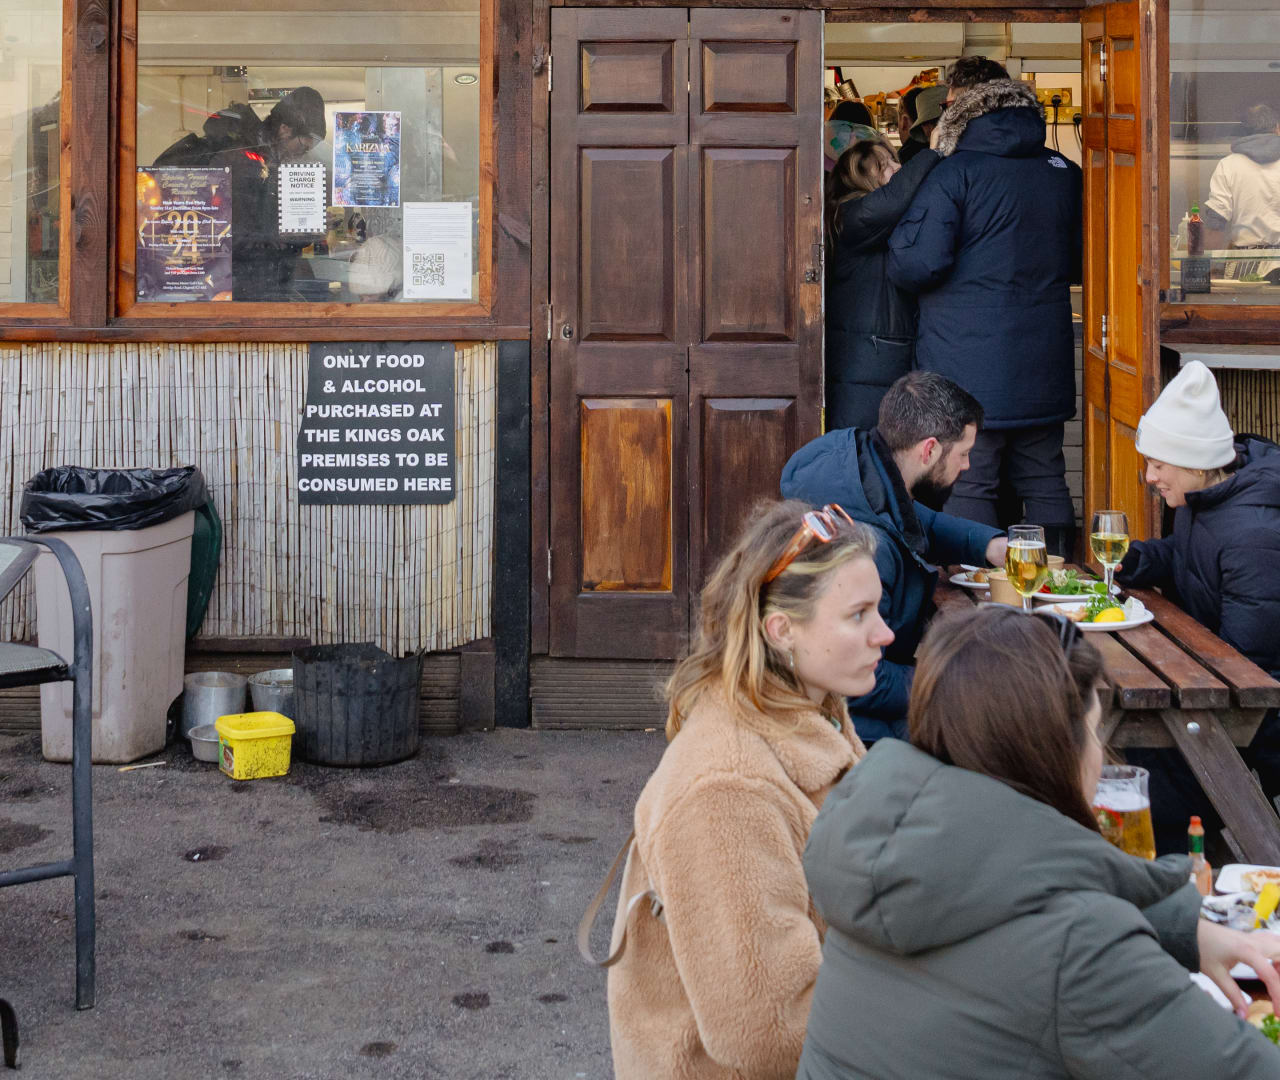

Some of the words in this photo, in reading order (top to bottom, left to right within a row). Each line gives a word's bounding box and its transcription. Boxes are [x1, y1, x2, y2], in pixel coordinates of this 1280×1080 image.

[323, 355, 371, 368] ONLY
[376, 354, 425, 368] FOOD
[323, 380, 336, 393] &
[341, 379, 426, 393] ALCOHOL
[306, 404, 415, 418] PURCHASED
[419, 404, 443, 417] AT
[304, 429, 340, 442] THE
[345, 429, 401, 442] KINGS
[407, 428, 445, 442] OAK
[301, 453, 391, 467] PREMISES
[395, 453, 420, 467] TO
[424, 453, 449, 467] BE
[298, 477, 399, 492] CONSUMED
[403, 477, 452, 491] HERE
